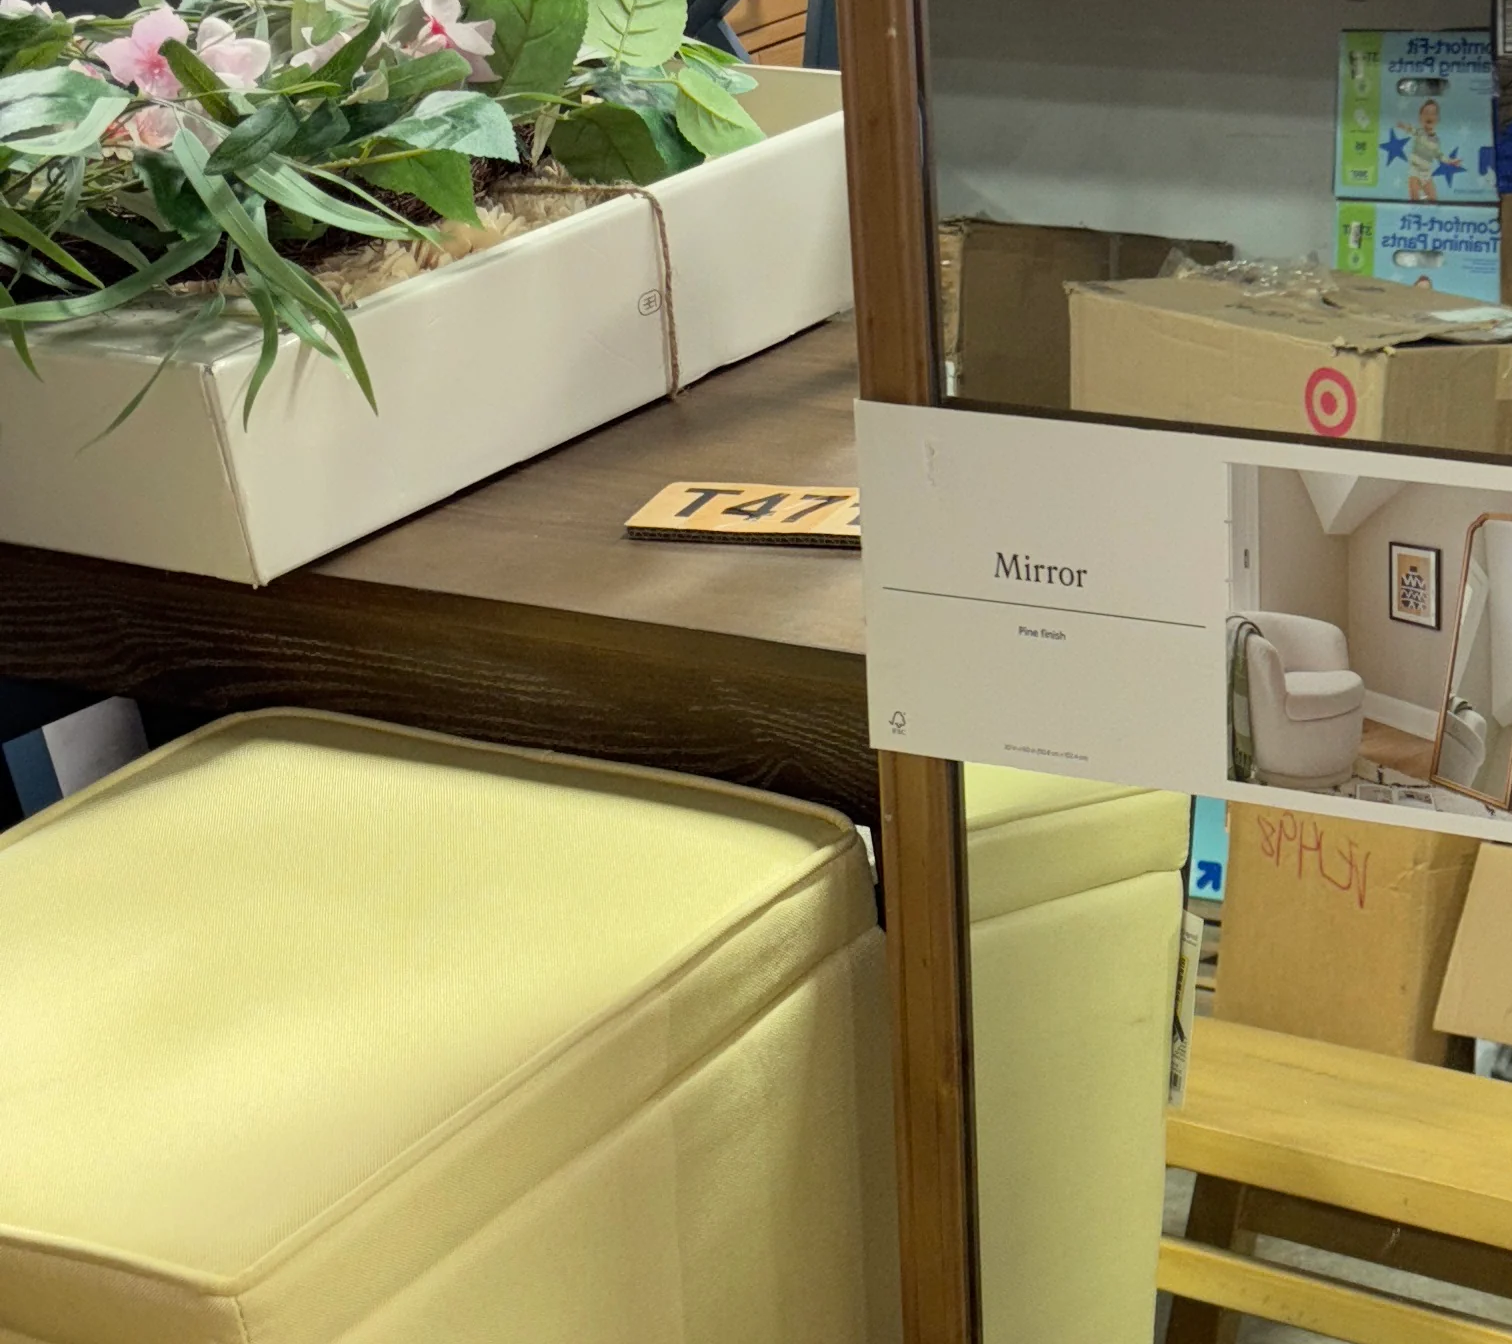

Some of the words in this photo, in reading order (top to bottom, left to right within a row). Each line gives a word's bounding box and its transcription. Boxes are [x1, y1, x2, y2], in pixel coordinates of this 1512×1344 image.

[994, 551, 1088, 588] Mirror
[1018, 625, 1039, 639] Pine
[1040, 627, 1067, 641] finish
